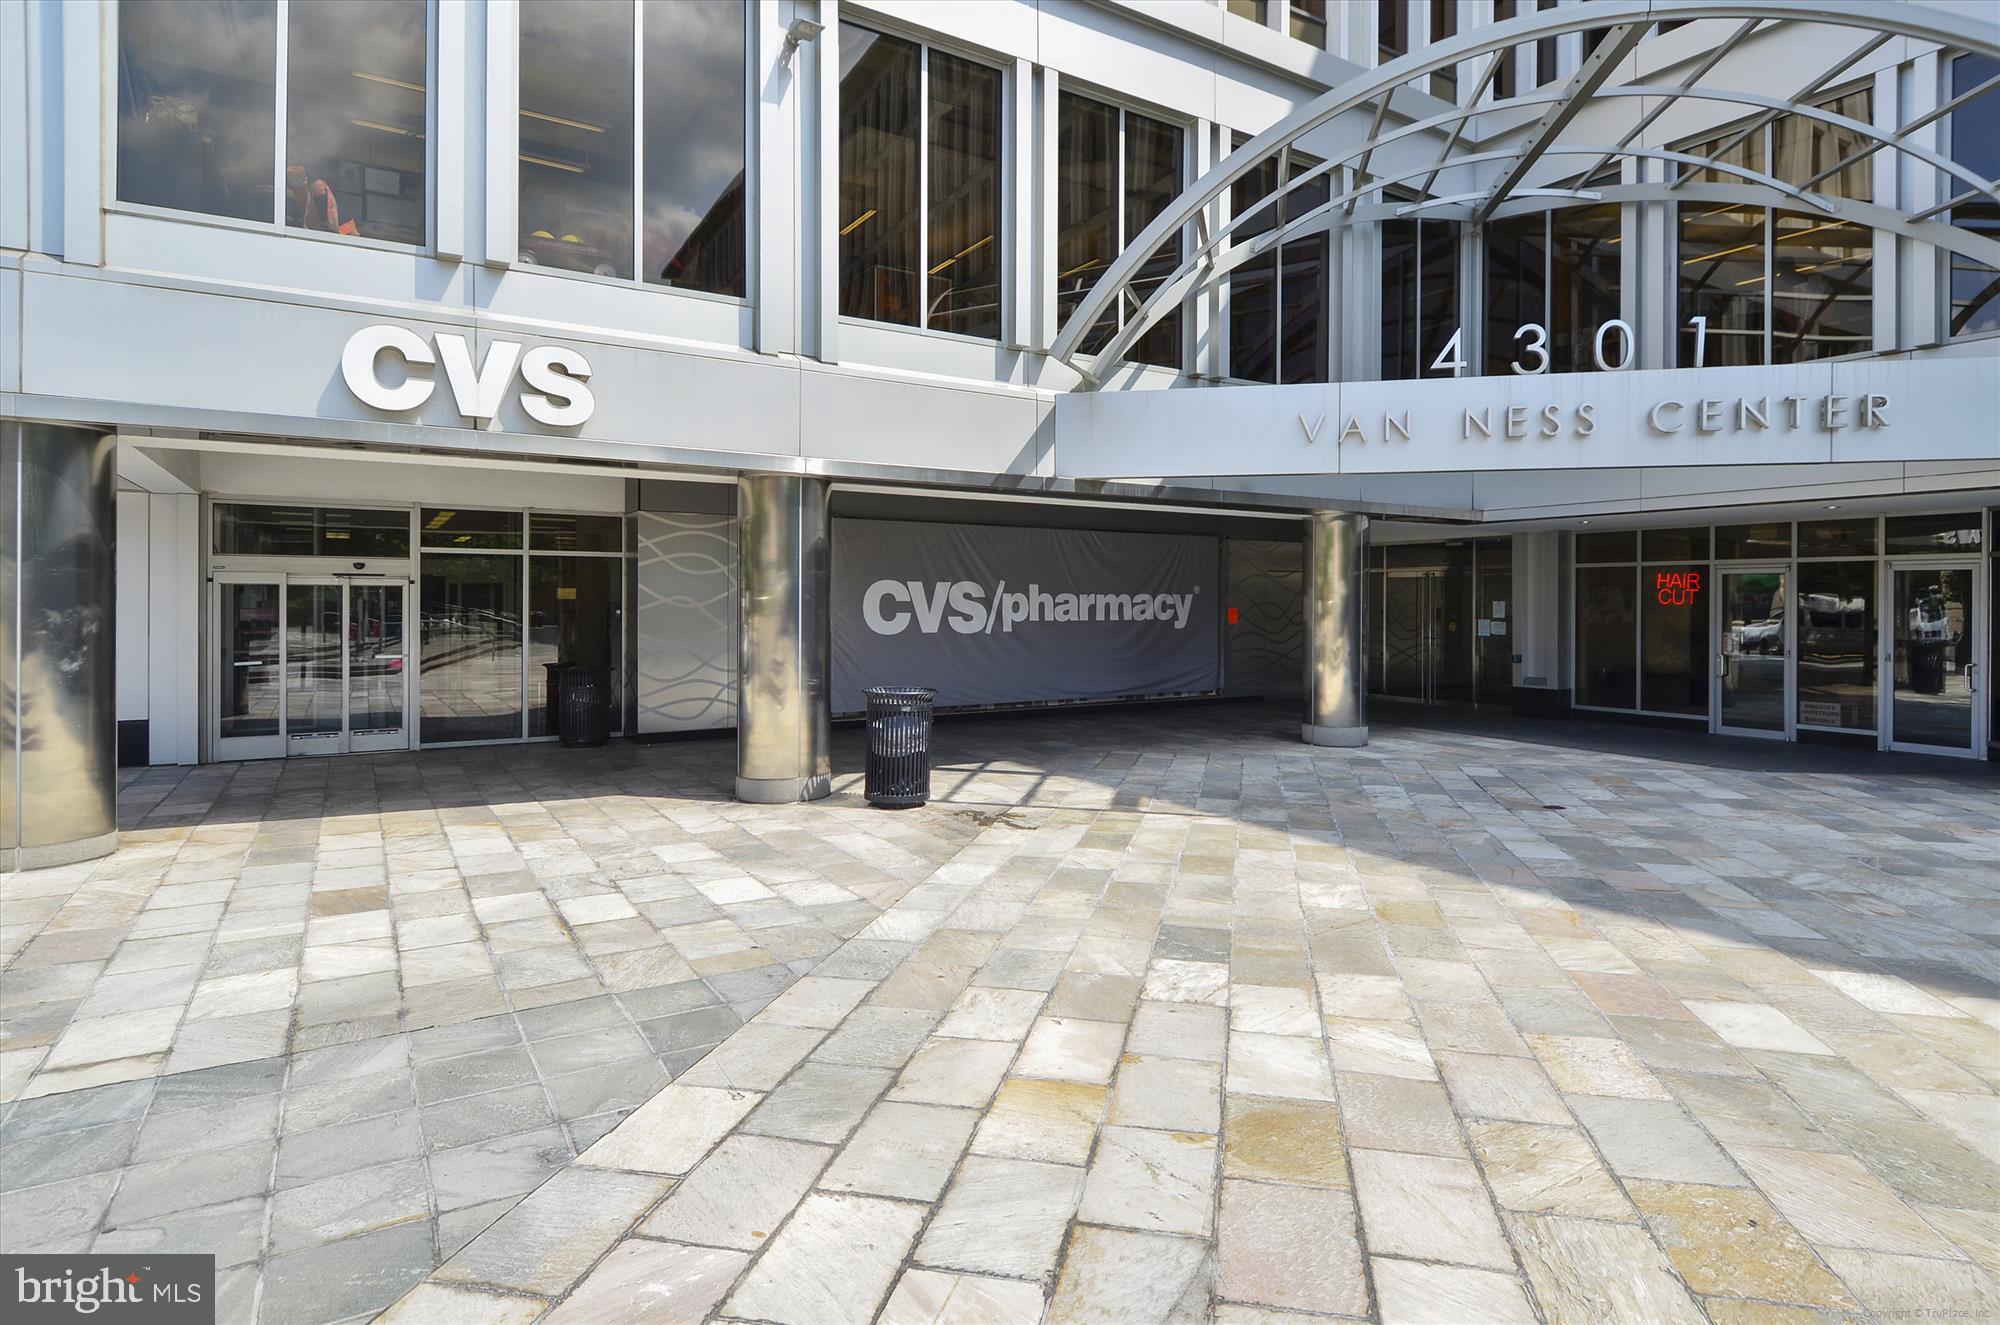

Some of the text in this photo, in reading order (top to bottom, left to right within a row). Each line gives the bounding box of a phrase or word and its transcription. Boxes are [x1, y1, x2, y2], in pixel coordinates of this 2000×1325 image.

[341, 324, 596, 428] CVS
[1298, 392, 1893, 444] VAN NESS CENTER
[1657, 573, 1701, 589] HAIR
[1658, 588, 1699, 605] CUT
